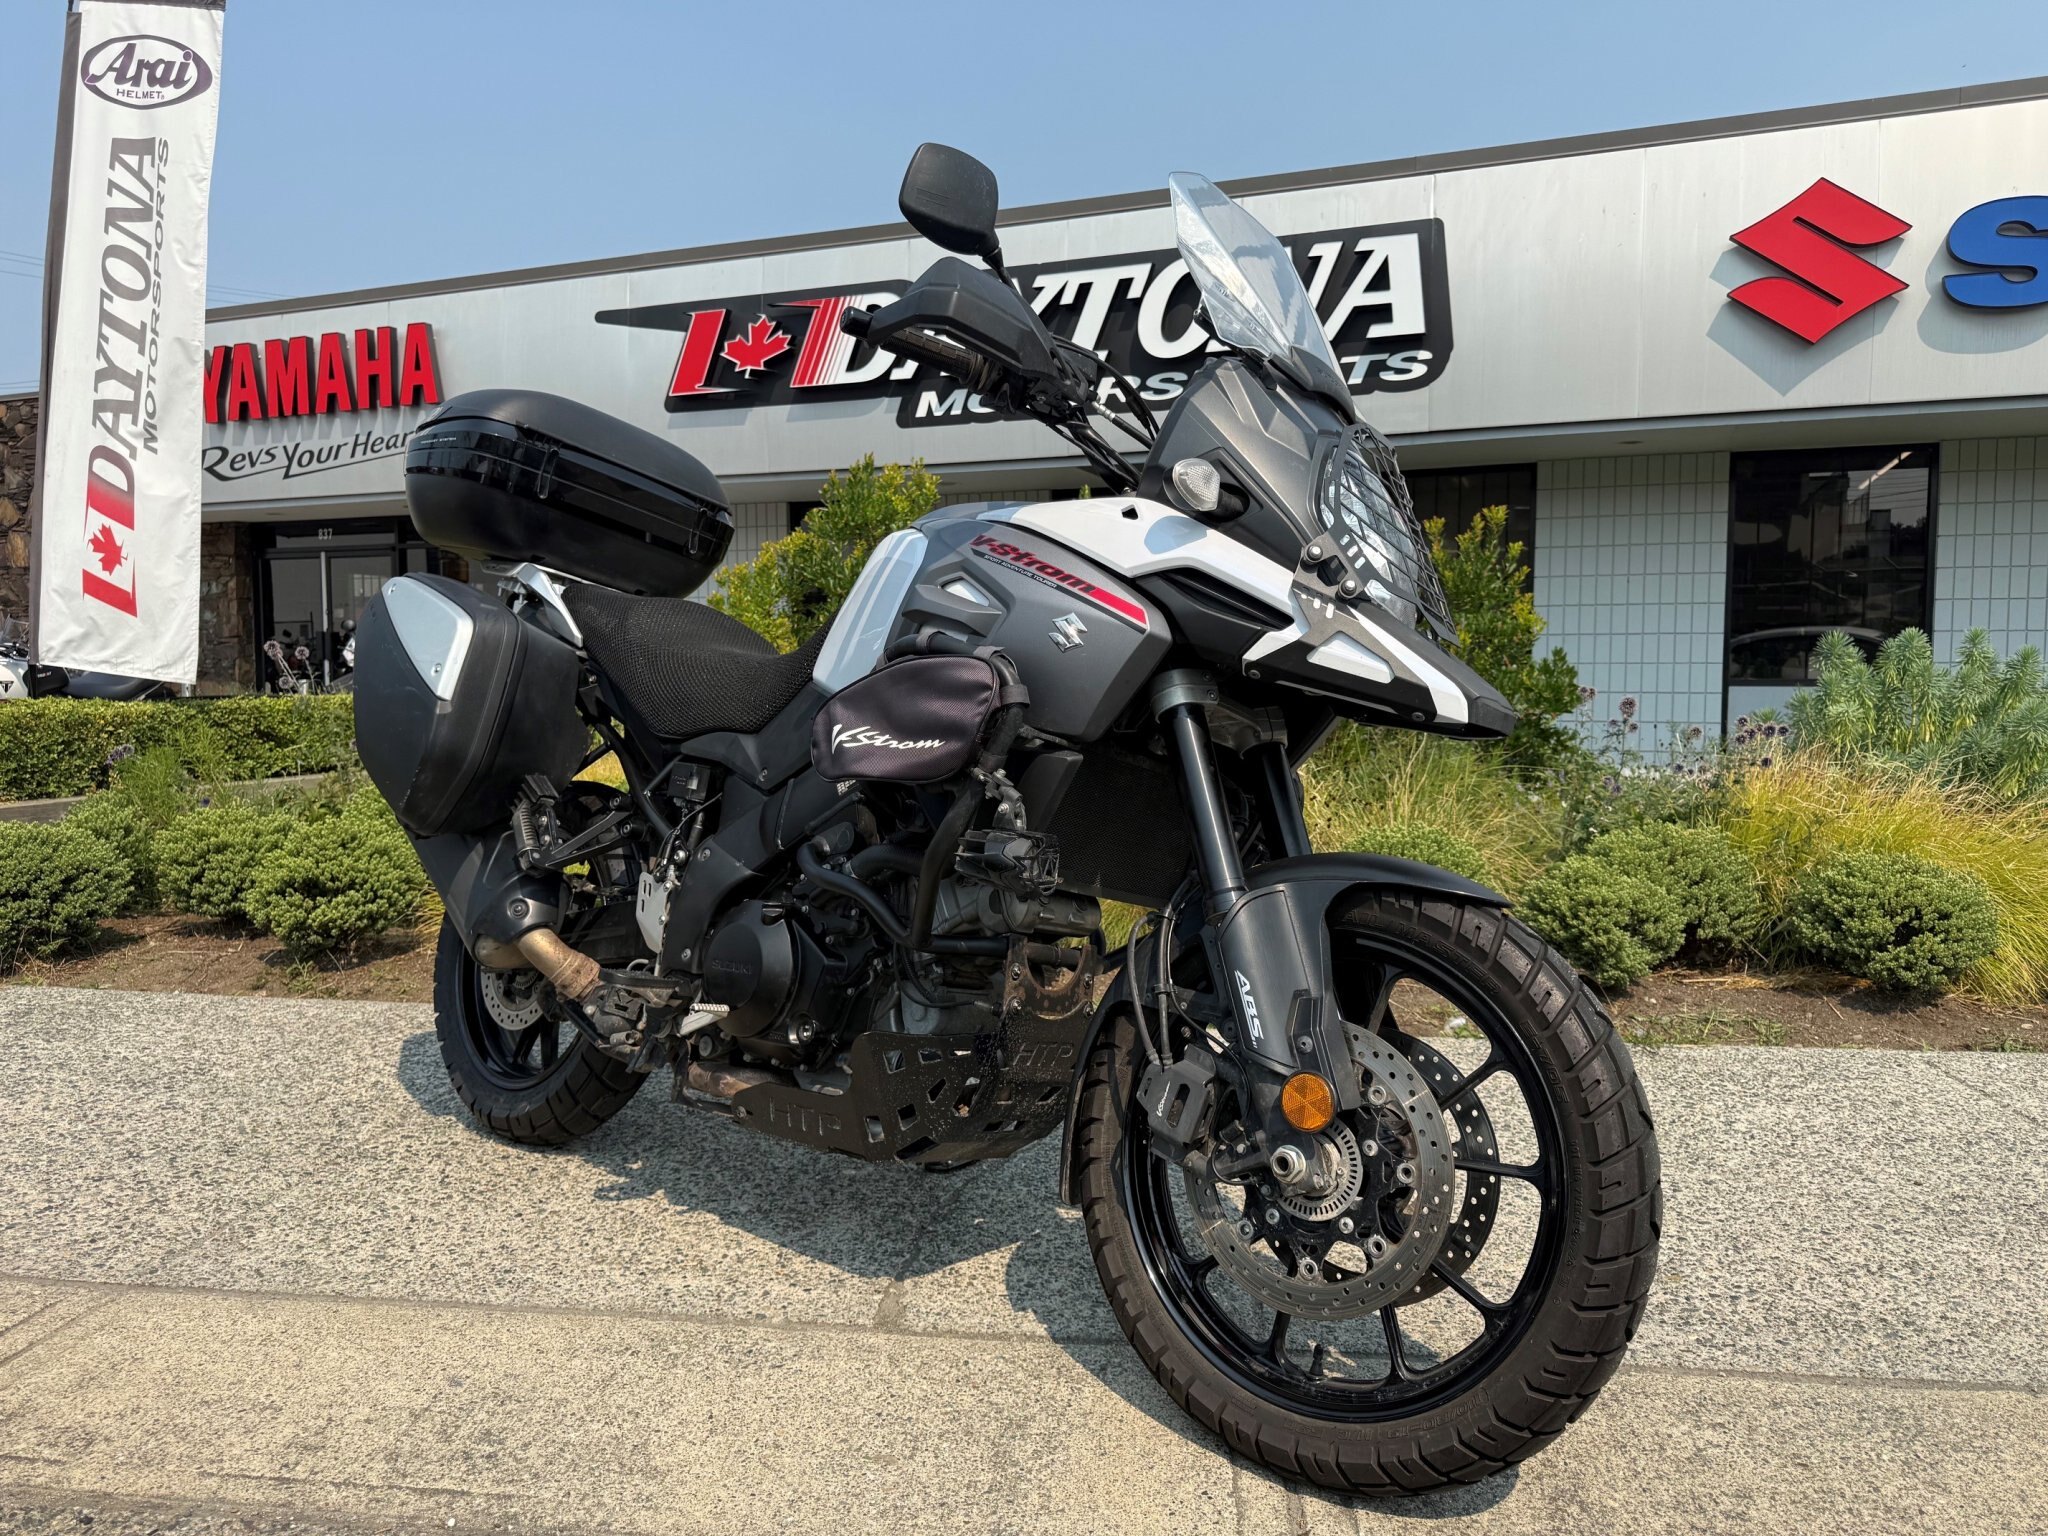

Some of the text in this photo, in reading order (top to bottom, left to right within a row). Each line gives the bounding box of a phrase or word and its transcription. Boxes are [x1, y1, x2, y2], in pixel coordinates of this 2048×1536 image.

[85, 42, 193, 90] Arai
[116, 88, 162, 100] HELMET
[142, 137, 169, 456] MOTORSPORTS
[86, 136, 156, 532] DAYTONA
[203, 322, 440, 425] YAMAHA
[203, 430, 416, 482] Revs Your Hear
[318, 528, 333, 540] 837
[984, 554, 1058, 589] SPORT ADVENTURE TOURER
[1235, 969, 1265, 1041] ABS
